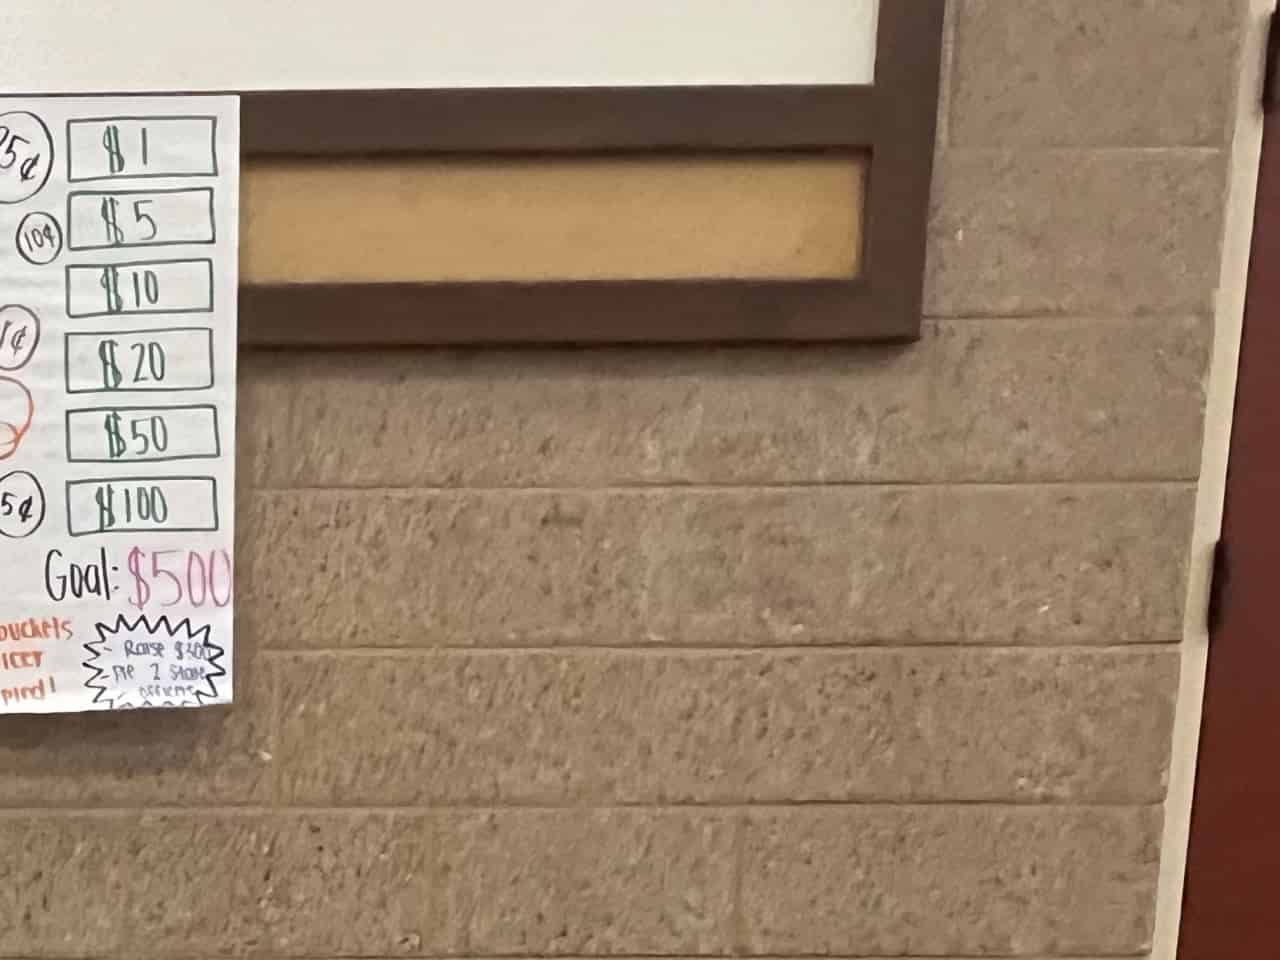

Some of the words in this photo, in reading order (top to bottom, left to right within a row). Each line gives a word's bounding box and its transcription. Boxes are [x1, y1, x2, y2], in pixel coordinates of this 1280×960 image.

[24, 223, 56, 253] 10¢
[100, 265, 159, 312] $10
[98, 339, 166, 389] $20
[104, 411, 168, 458] $50
[0, 492, 34, 523] 5¢
[95, 484, 168, 532] $100
[45, 546, 120, 601] Goal:
[127, 546, 232, 610] $500
